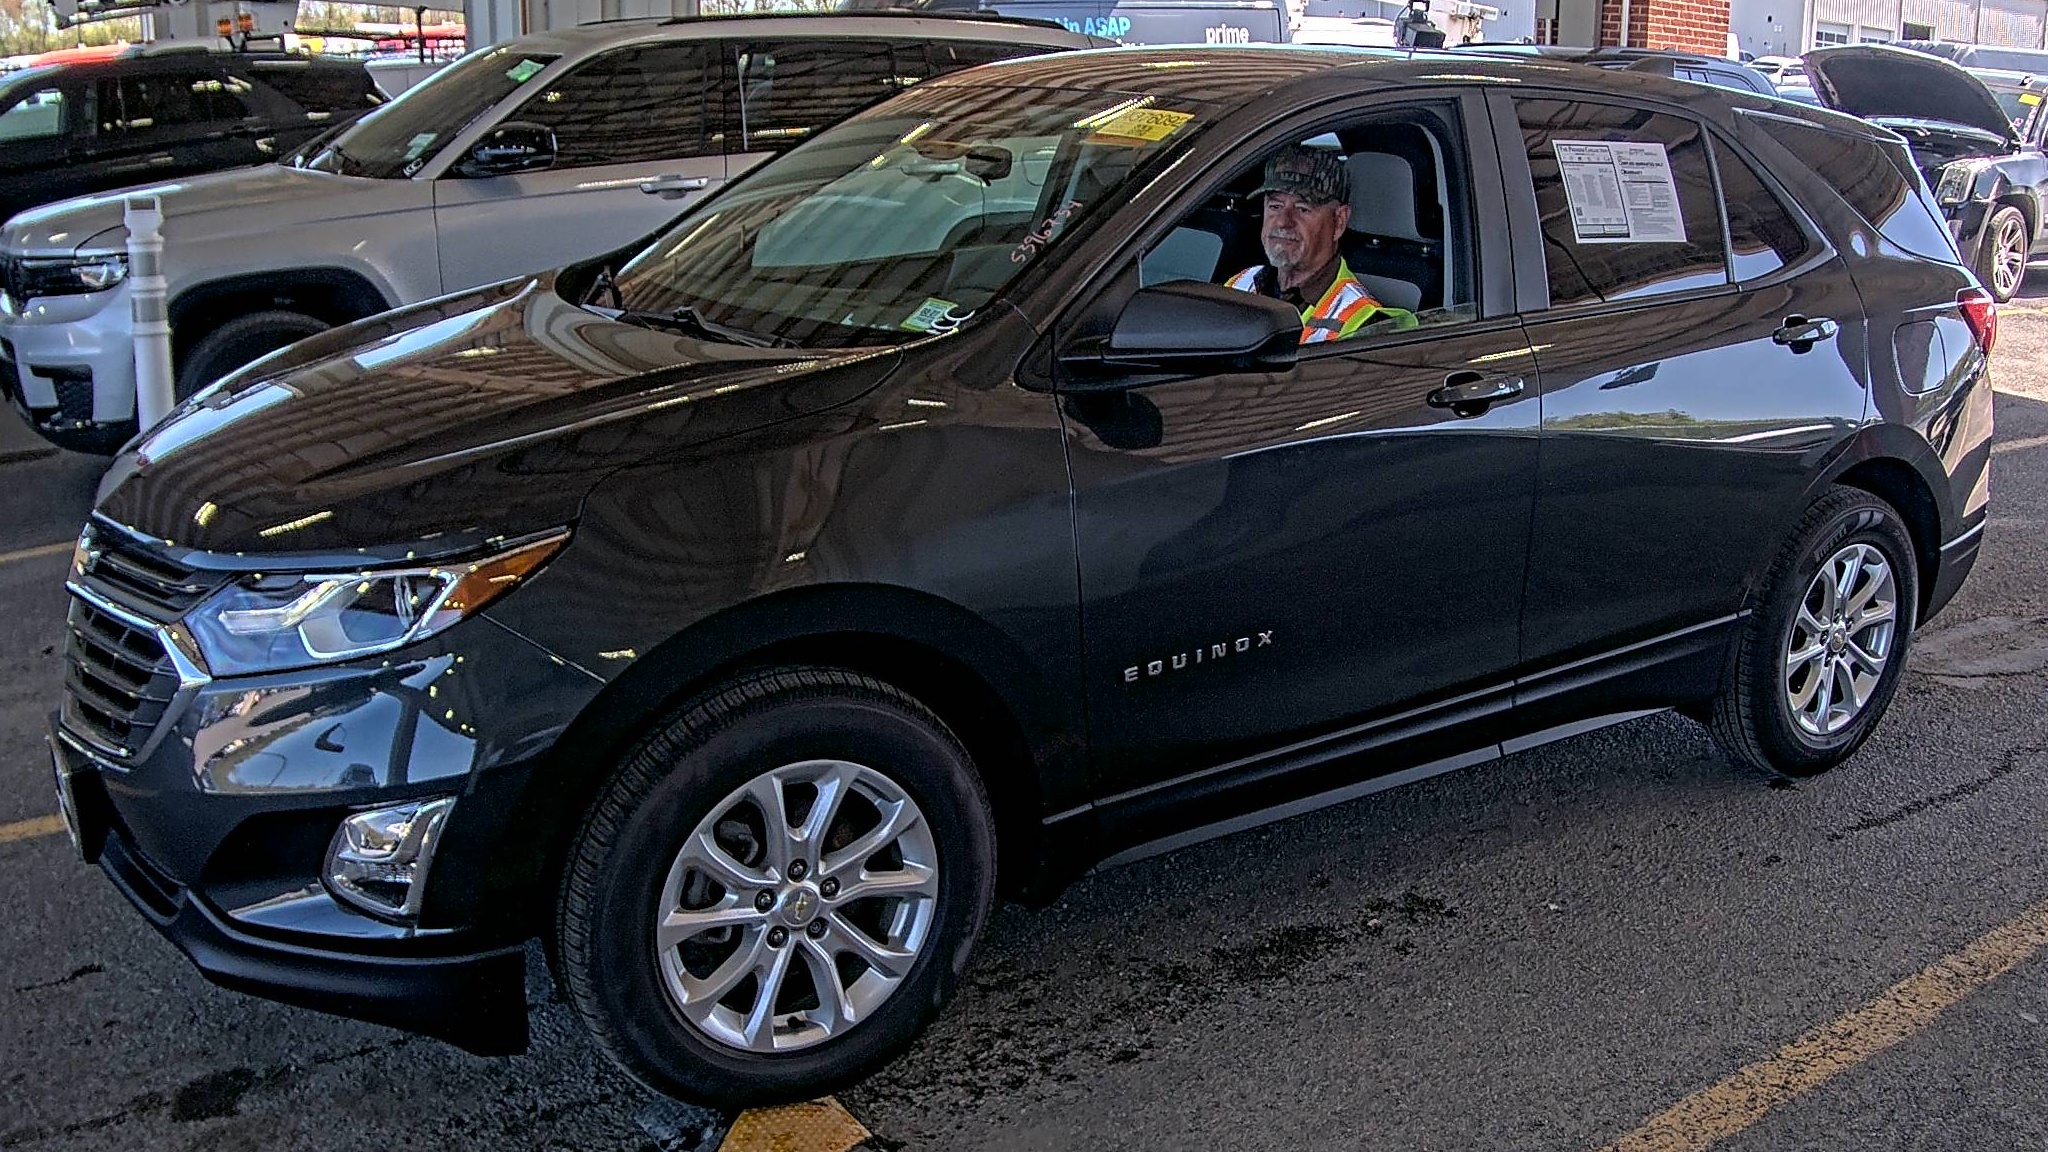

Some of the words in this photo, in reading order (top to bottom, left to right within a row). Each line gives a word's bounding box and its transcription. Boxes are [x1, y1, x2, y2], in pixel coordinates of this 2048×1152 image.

[1084, 17, 1131, 36] ASAP
[1205, 24, 1249, 44] prime
[1124, 630, 1273, 683] EQUINOX
